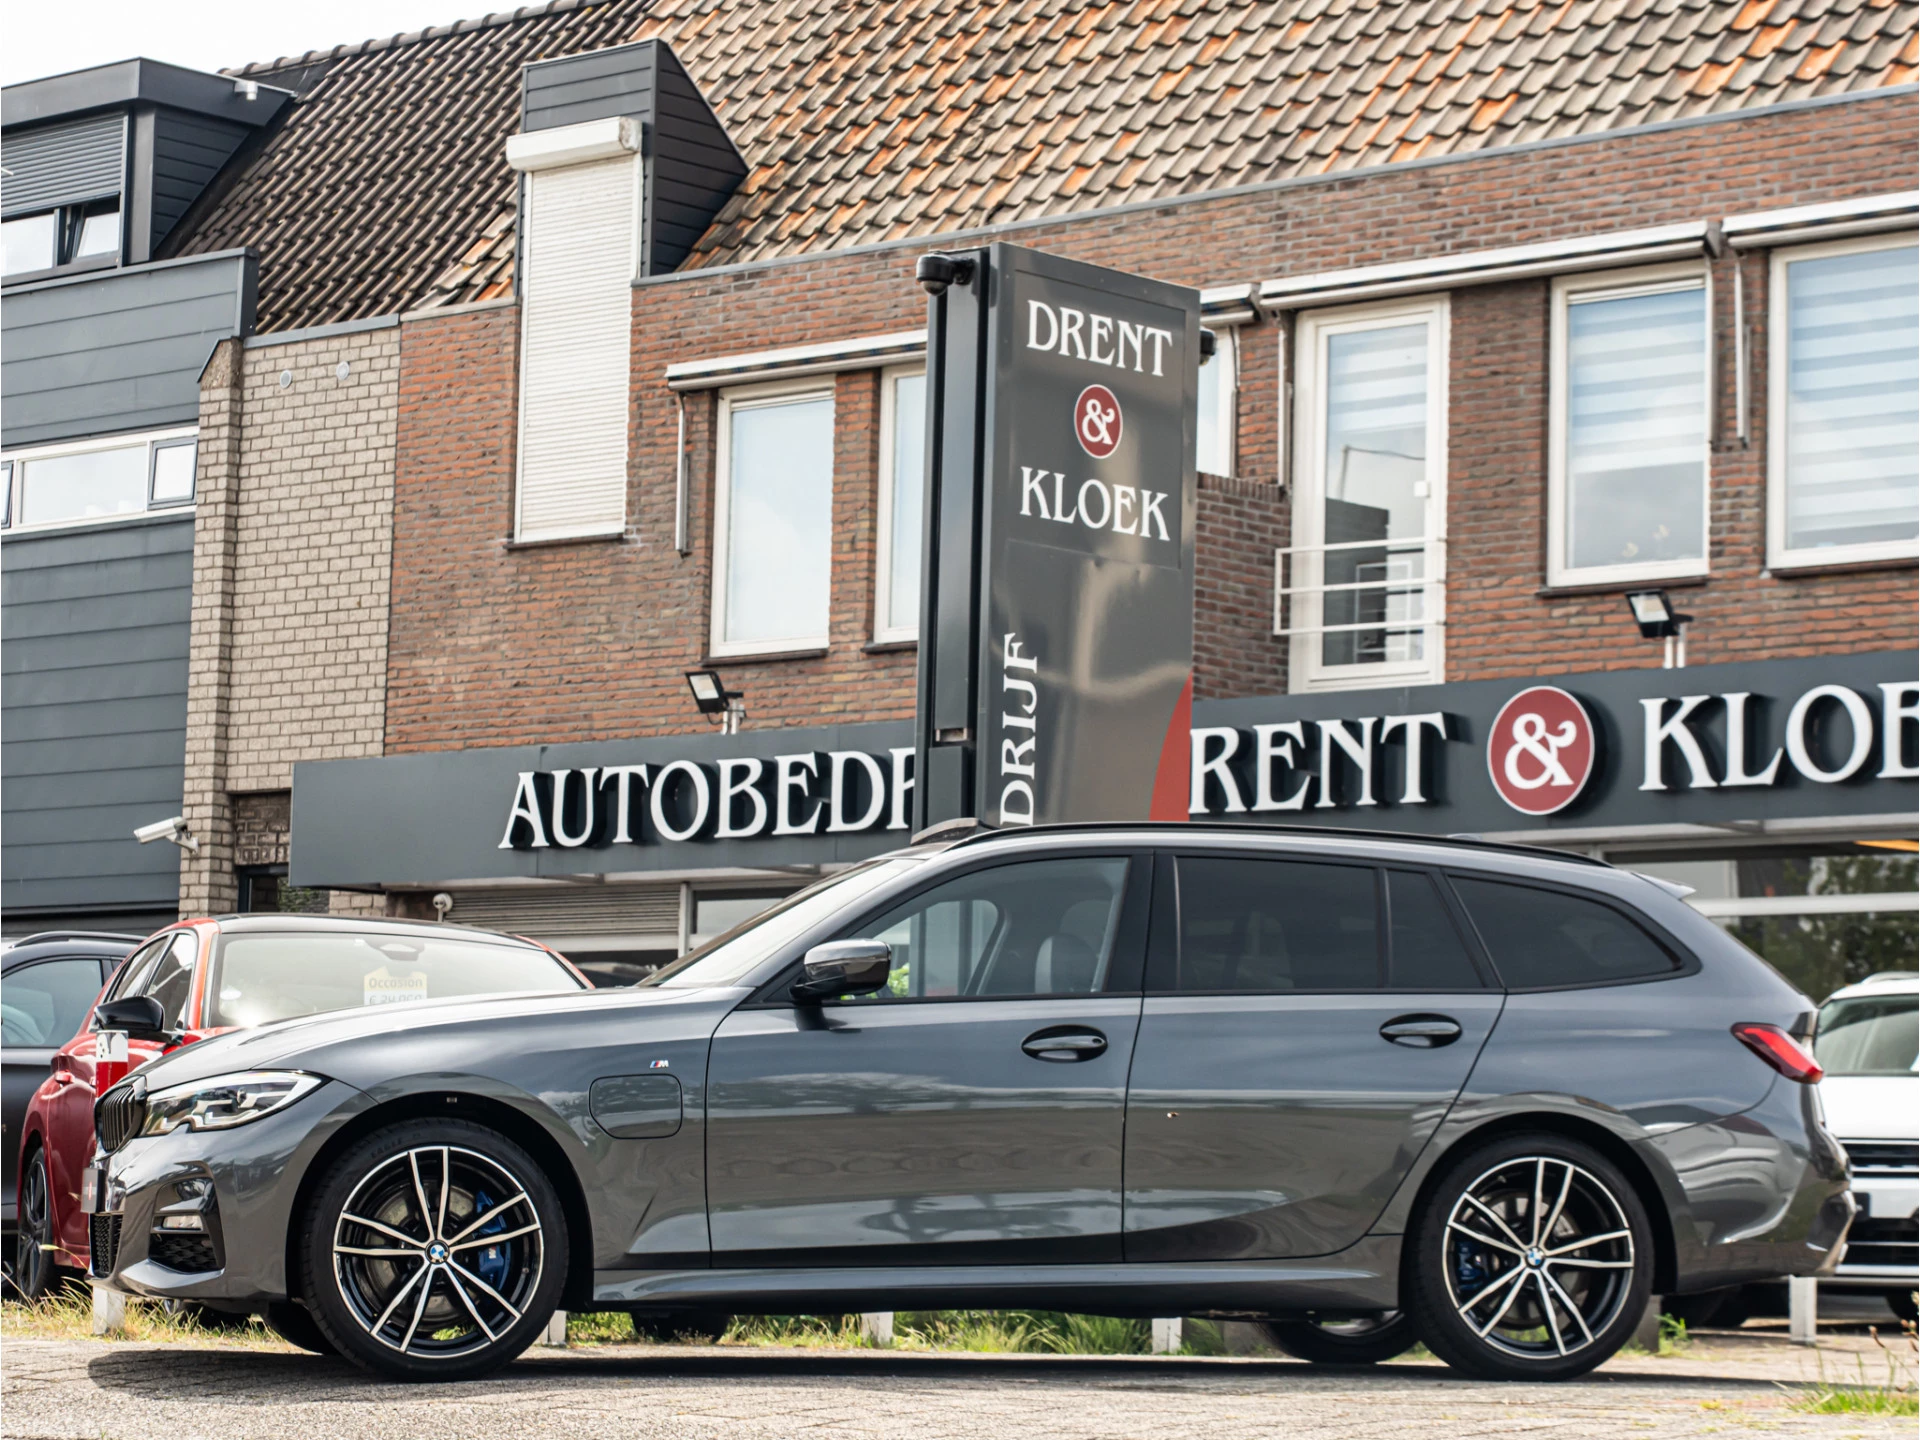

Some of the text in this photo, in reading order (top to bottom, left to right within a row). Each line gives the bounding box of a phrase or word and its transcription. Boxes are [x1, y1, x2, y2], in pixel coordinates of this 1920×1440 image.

[1027, 299, 1173, 377] DRENT
[1081, 398, 1116, 446] &
[1019, 466, 1171, 542] KLOEK
[1503, 712, 1578, 790] &
[368, 976, 423, 988] Occasion
